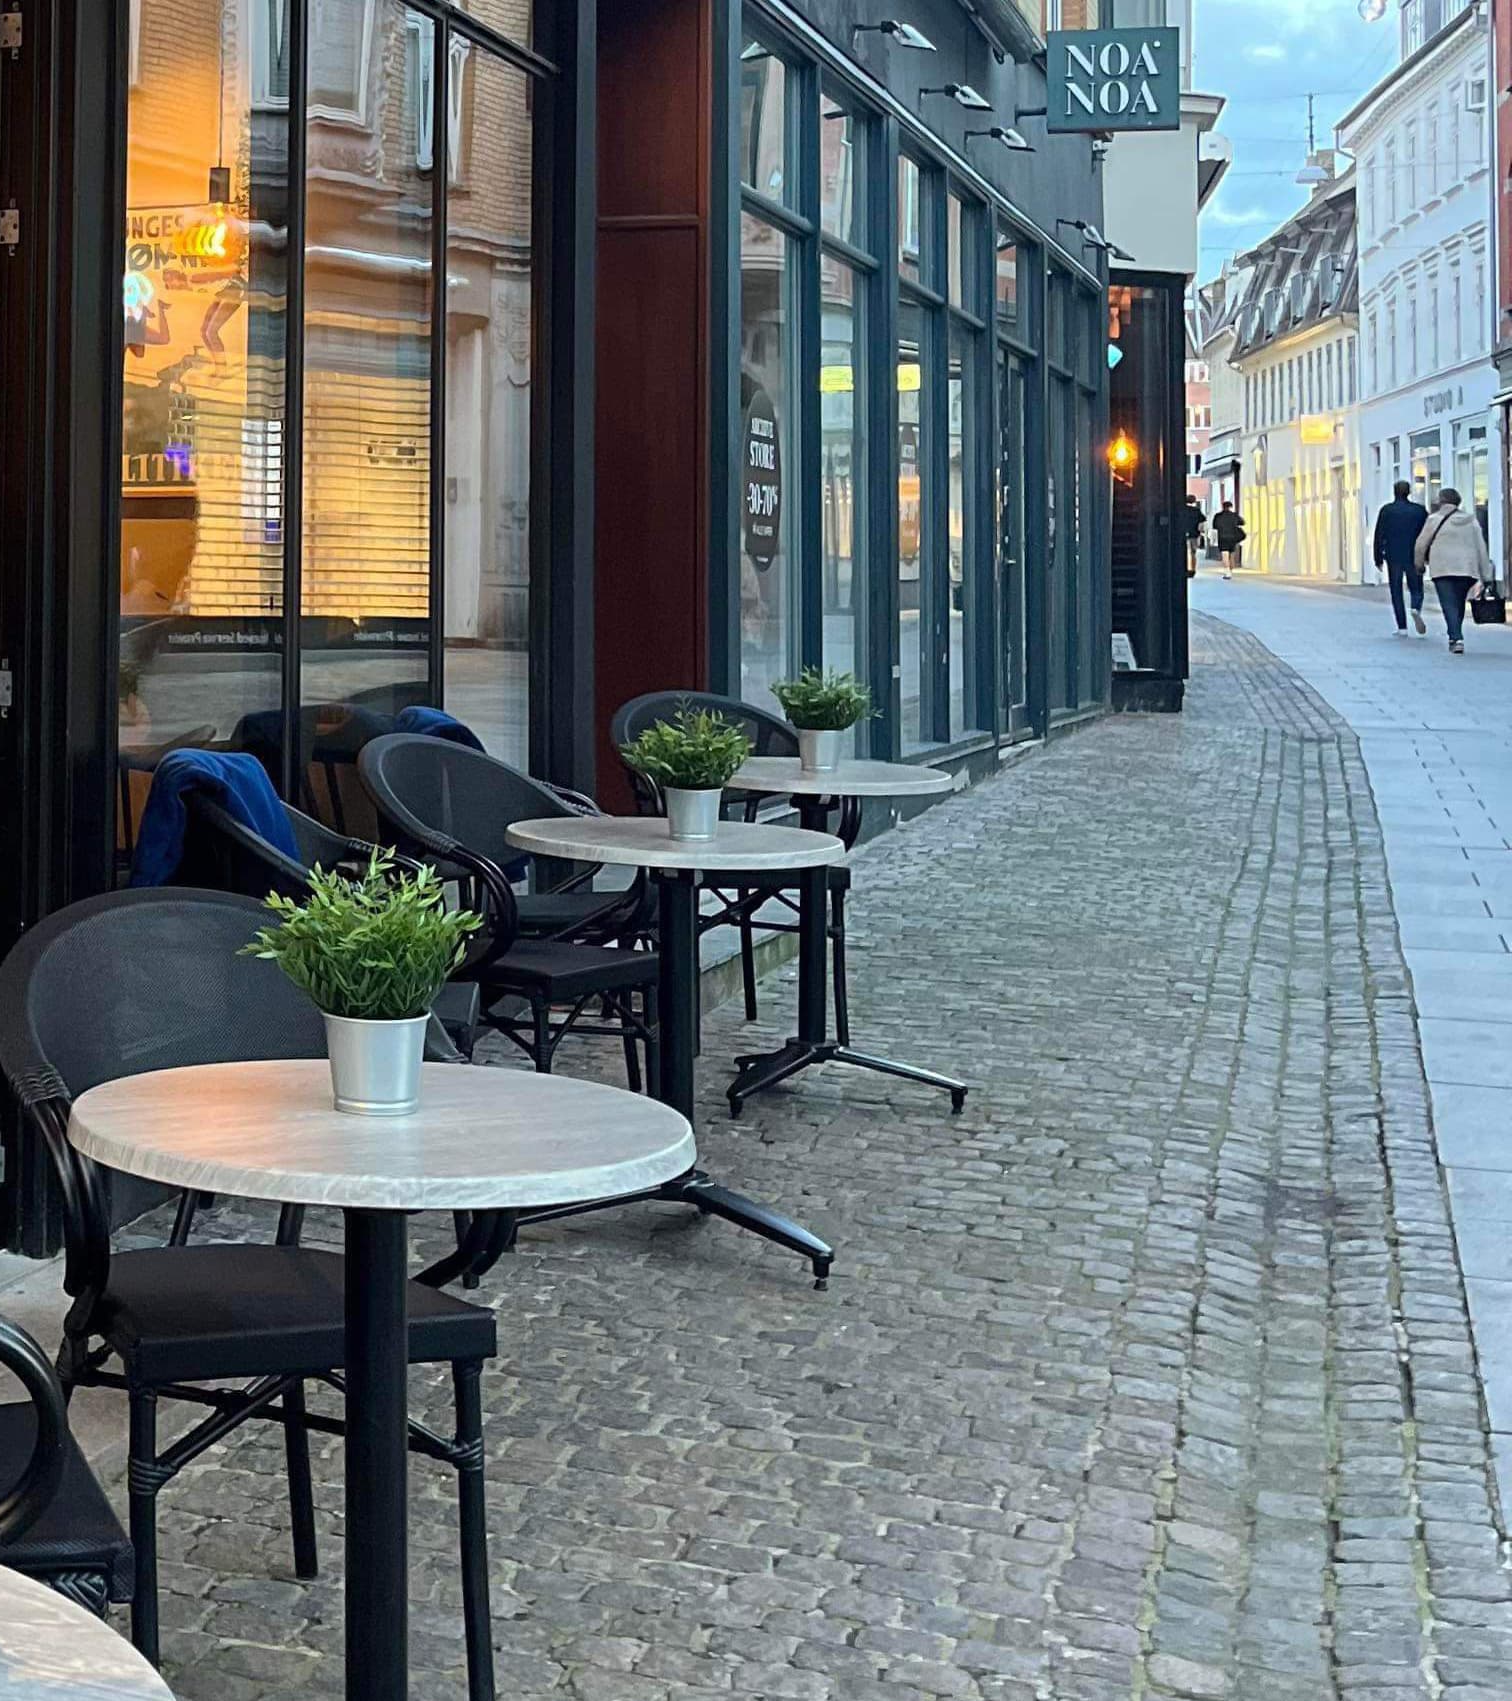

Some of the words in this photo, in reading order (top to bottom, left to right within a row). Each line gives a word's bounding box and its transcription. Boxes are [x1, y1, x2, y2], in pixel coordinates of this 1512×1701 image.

[1065, 42, 1160, 77] NOA
[1065, 80, 1159, 115] NOA
[749, 440, 775, 470] STORE
